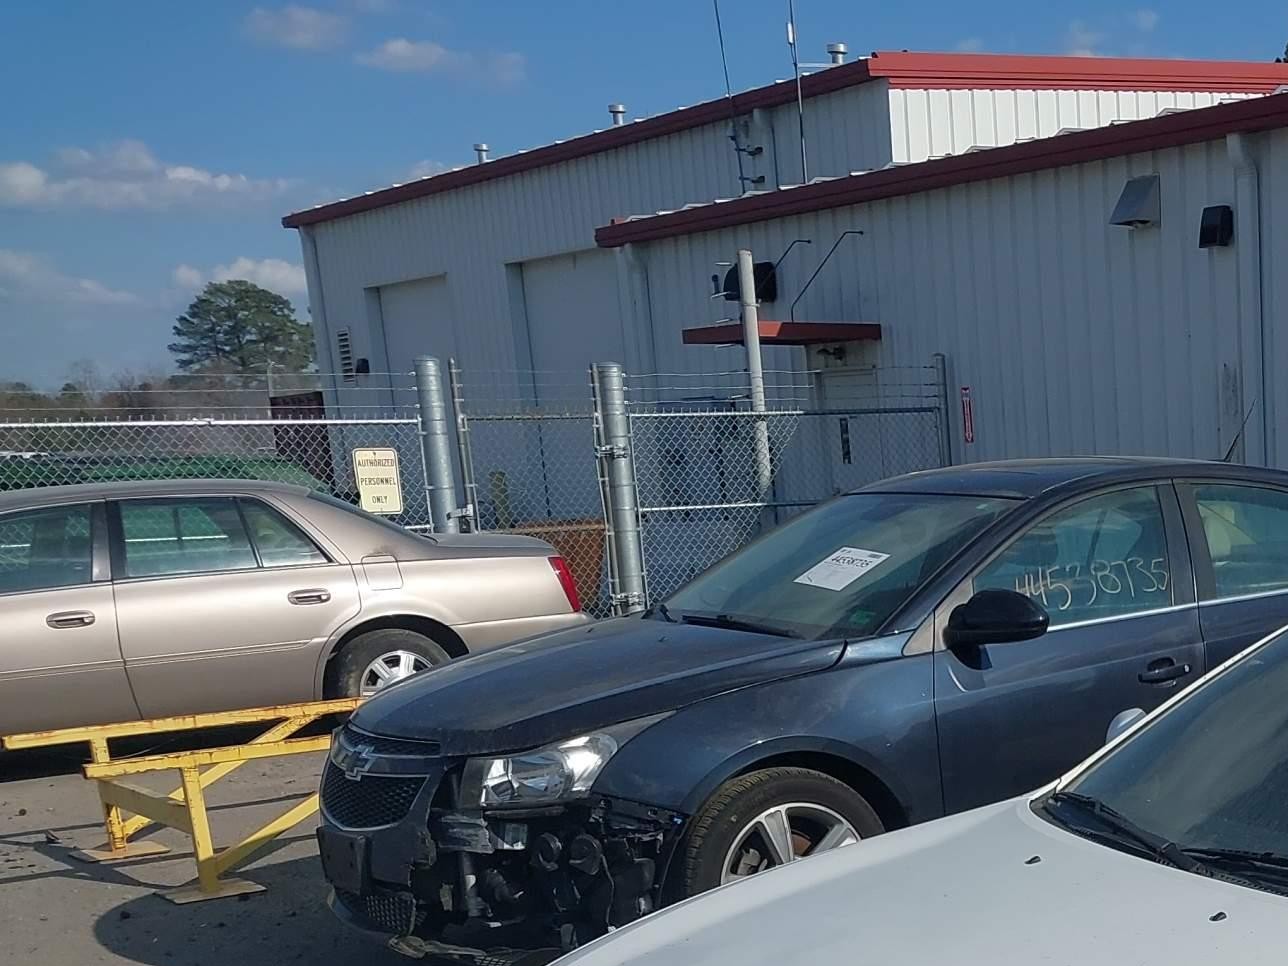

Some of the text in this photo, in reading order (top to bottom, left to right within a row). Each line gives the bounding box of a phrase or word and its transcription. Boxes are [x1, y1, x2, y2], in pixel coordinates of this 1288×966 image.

[357, 458, 395, 468] AUTHORIZED
[360, 477, 397, 486] PERSONNEL
[371, 495, 388, 504] ONLY
[1015, 556, 1170, 611] 44538735
